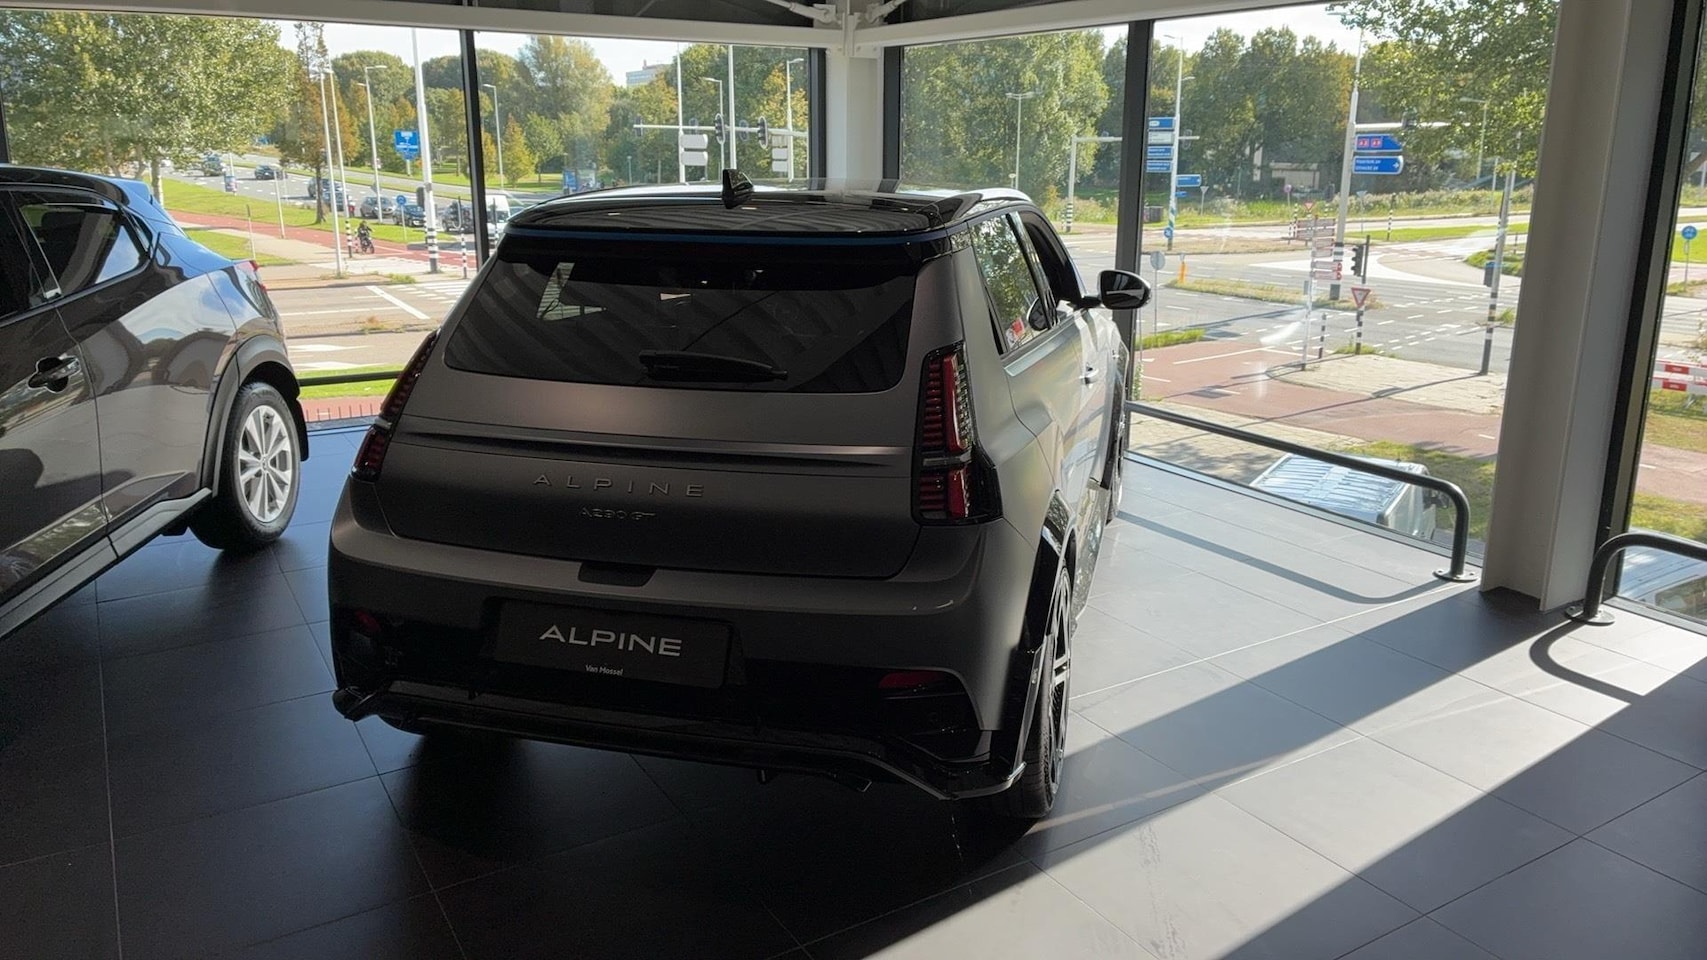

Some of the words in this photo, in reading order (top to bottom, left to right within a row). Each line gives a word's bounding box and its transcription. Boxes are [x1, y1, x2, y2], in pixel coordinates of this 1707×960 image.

[533, 474, 704, 497] ALPINE
[539, 624, 682, 657] ALPINE
[585, 664, 598, 673] Van
[599, 666, 624, 676] Mossel
